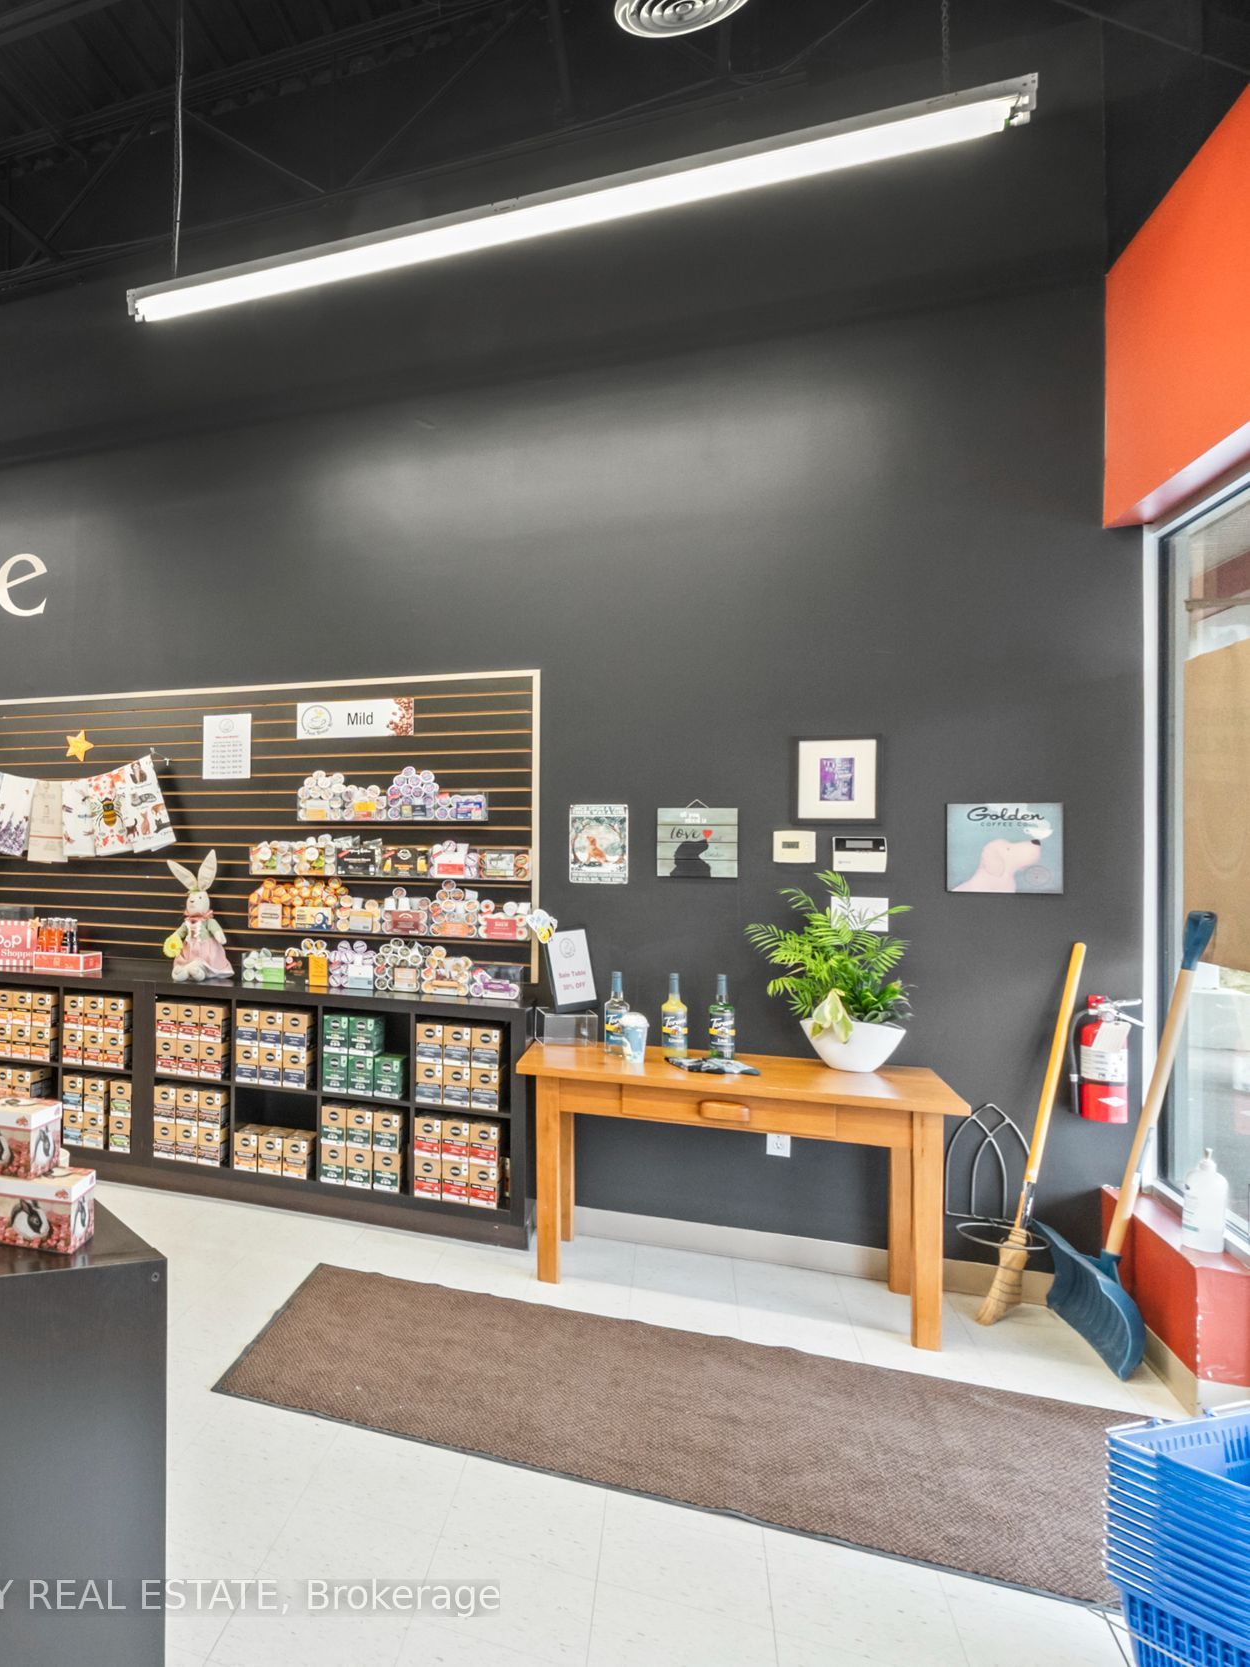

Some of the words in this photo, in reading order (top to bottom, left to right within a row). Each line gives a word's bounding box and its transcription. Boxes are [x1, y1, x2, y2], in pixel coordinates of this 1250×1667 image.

[347, 711, 374, 726] Mild
[966, 806, 1045, 822] Golden
[670, 826, 701, 840] love
[0, 948, 33, 960] Shoppe
